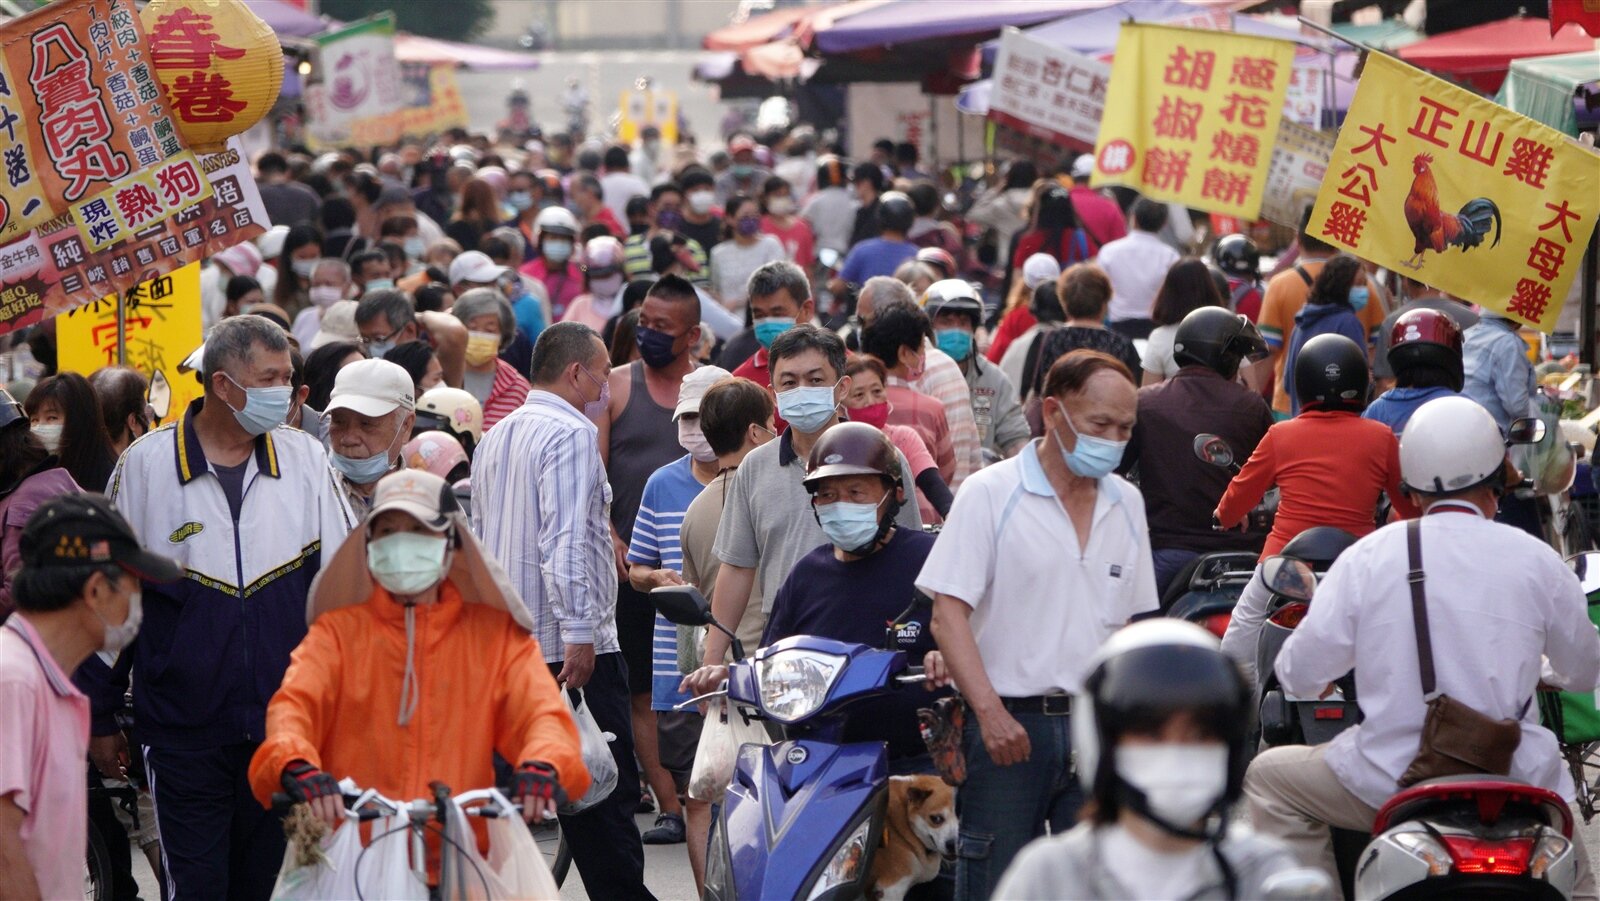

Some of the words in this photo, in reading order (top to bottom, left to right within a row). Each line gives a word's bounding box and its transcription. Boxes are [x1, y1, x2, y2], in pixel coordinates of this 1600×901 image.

[0, 71, 41, 216] 十送一
[31, 24, 128, 199] 八寶肉丸
[1141, 46, 1215, 192] 胡椒餅
[1407, 96, 1554, 190] 正山雞
[79, 198, 119, 245] 現炸
[116, 160, 201, 228] 熱狗
[1322, 123, 1397, 248] 大公雞
[1, 244, 40, 270] 金牛角
[63, 210, 250, 294] 三峽銷售冠軍名店
[1506, 200, 1581, 324] 大母雞
